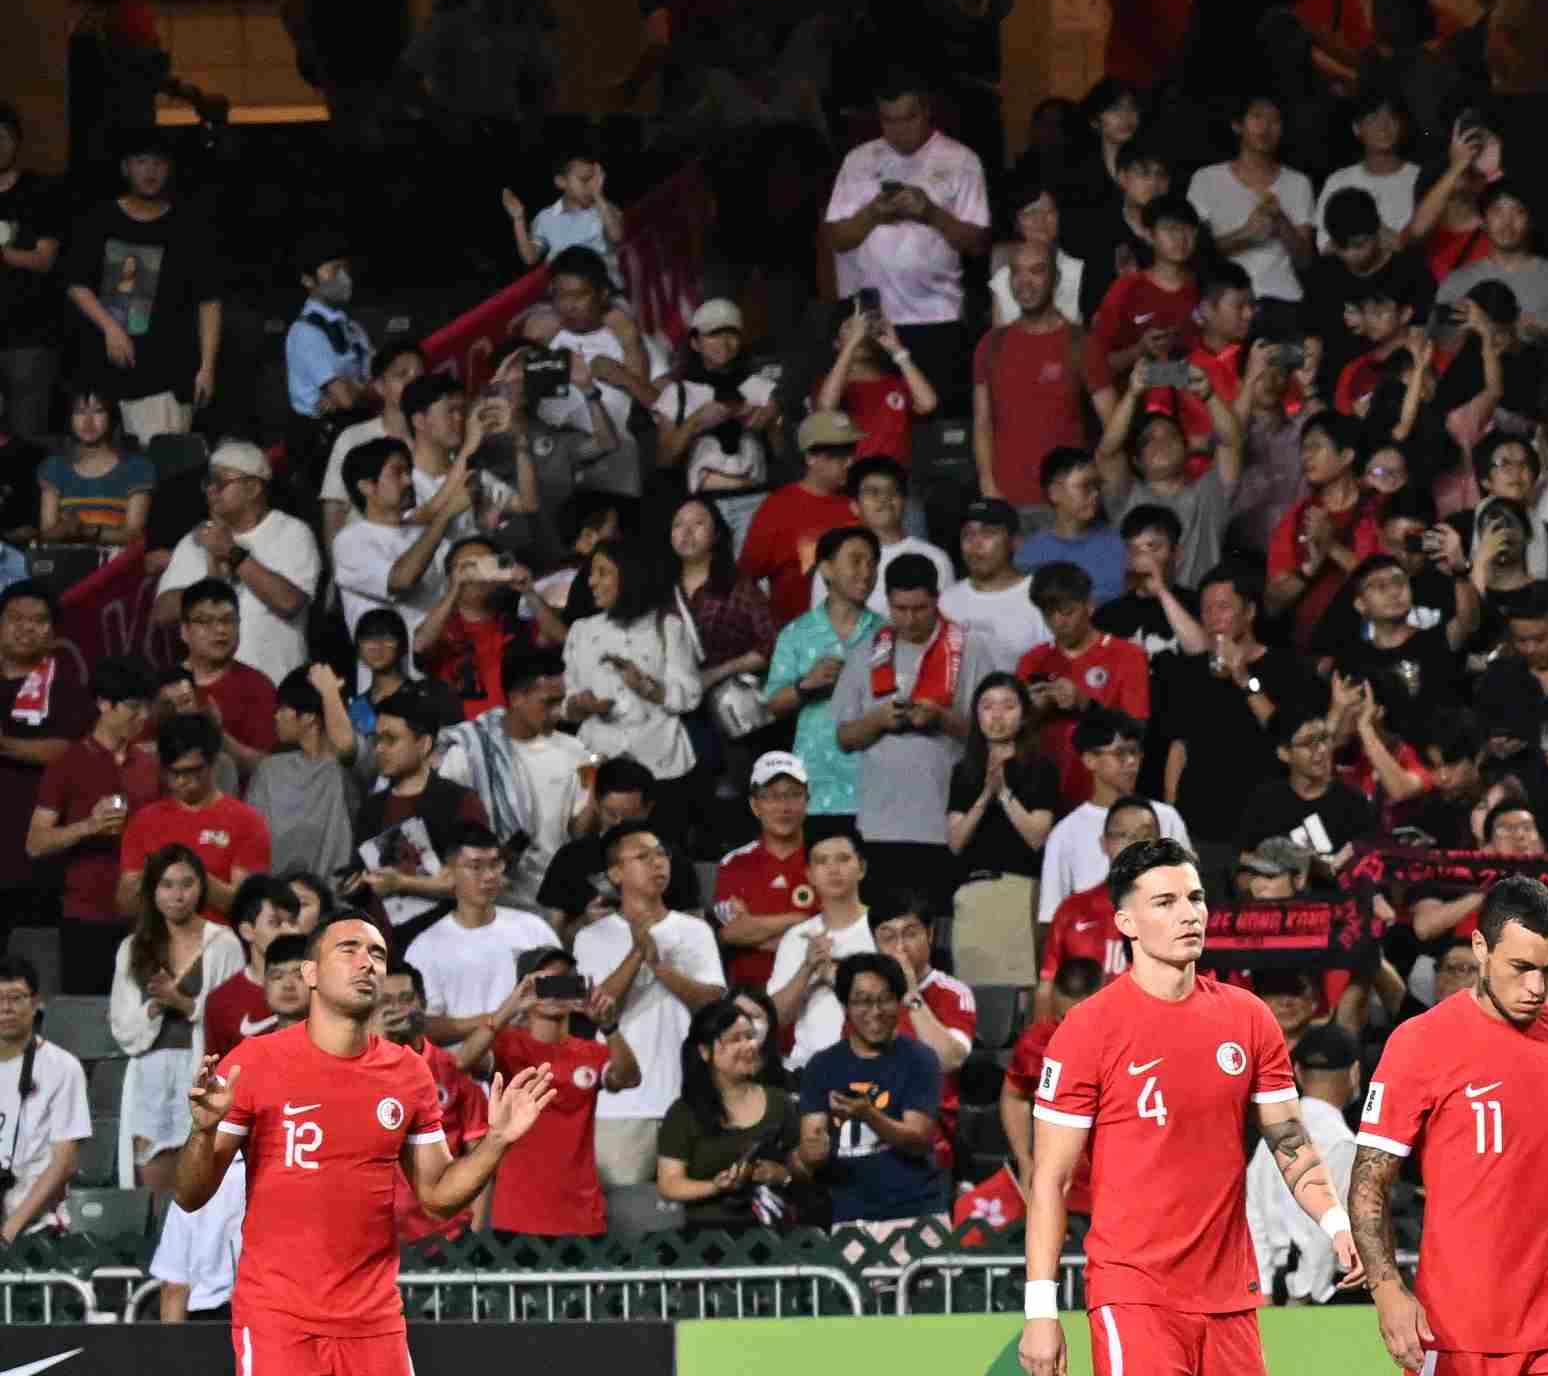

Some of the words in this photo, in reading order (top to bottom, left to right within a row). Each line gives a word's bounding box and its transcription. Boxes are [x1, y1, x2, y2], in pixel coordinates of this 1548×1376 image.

[1138, 1076, 1167, 1126] 4
[283, 1120, 322, 1169] 12
[1471, 1101, 1502, 1154] 11
